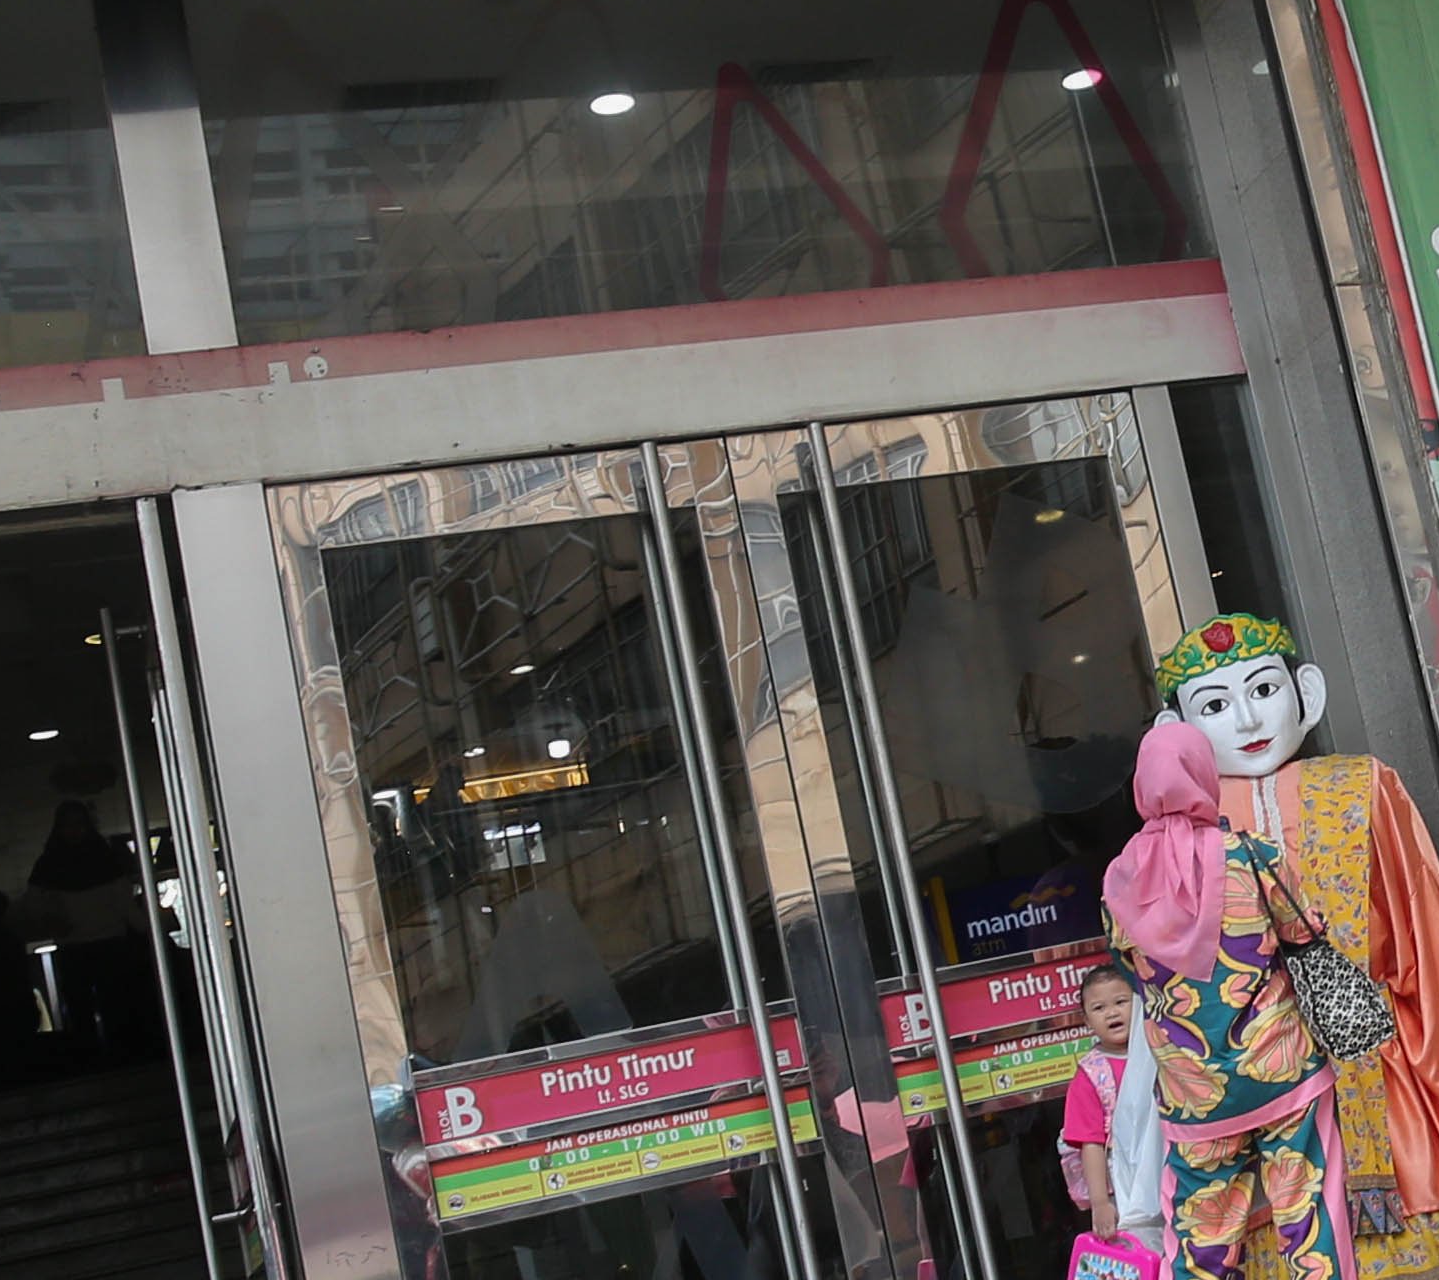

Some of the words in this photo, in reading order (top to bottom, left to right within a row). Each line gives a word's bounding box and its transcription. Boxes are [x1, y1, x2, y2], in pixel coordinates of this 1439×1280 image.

[989, 973, 1051, 1004] Pintu
[1039, 997, 1056, 1011] Lt.
[992, 1041, 1018, 1056] JAM
[1022, 1025, 1095, 1050] OPERASION
[541, 1059, 613, 1097] Pintu
[618, 1045, 696, 1076] Timur
[981, 1051, 1034, 1072] 0.00
[597, 1086, 615, 1104] Lt.
[619, 1081, 650, 1101] SLG
[445, 1087, 483, 1138] B
[528, 1147, 590, 1172] 0.00
[622, 1127, 681, 1152] 17.00
[691, 1119, 727, 1138] WIB
[544, 1137, 573, 1154] JAM
[577, 1117, 669, 1146] OPERASIONAL
[672, 1109, 709, 1127] PINTU
